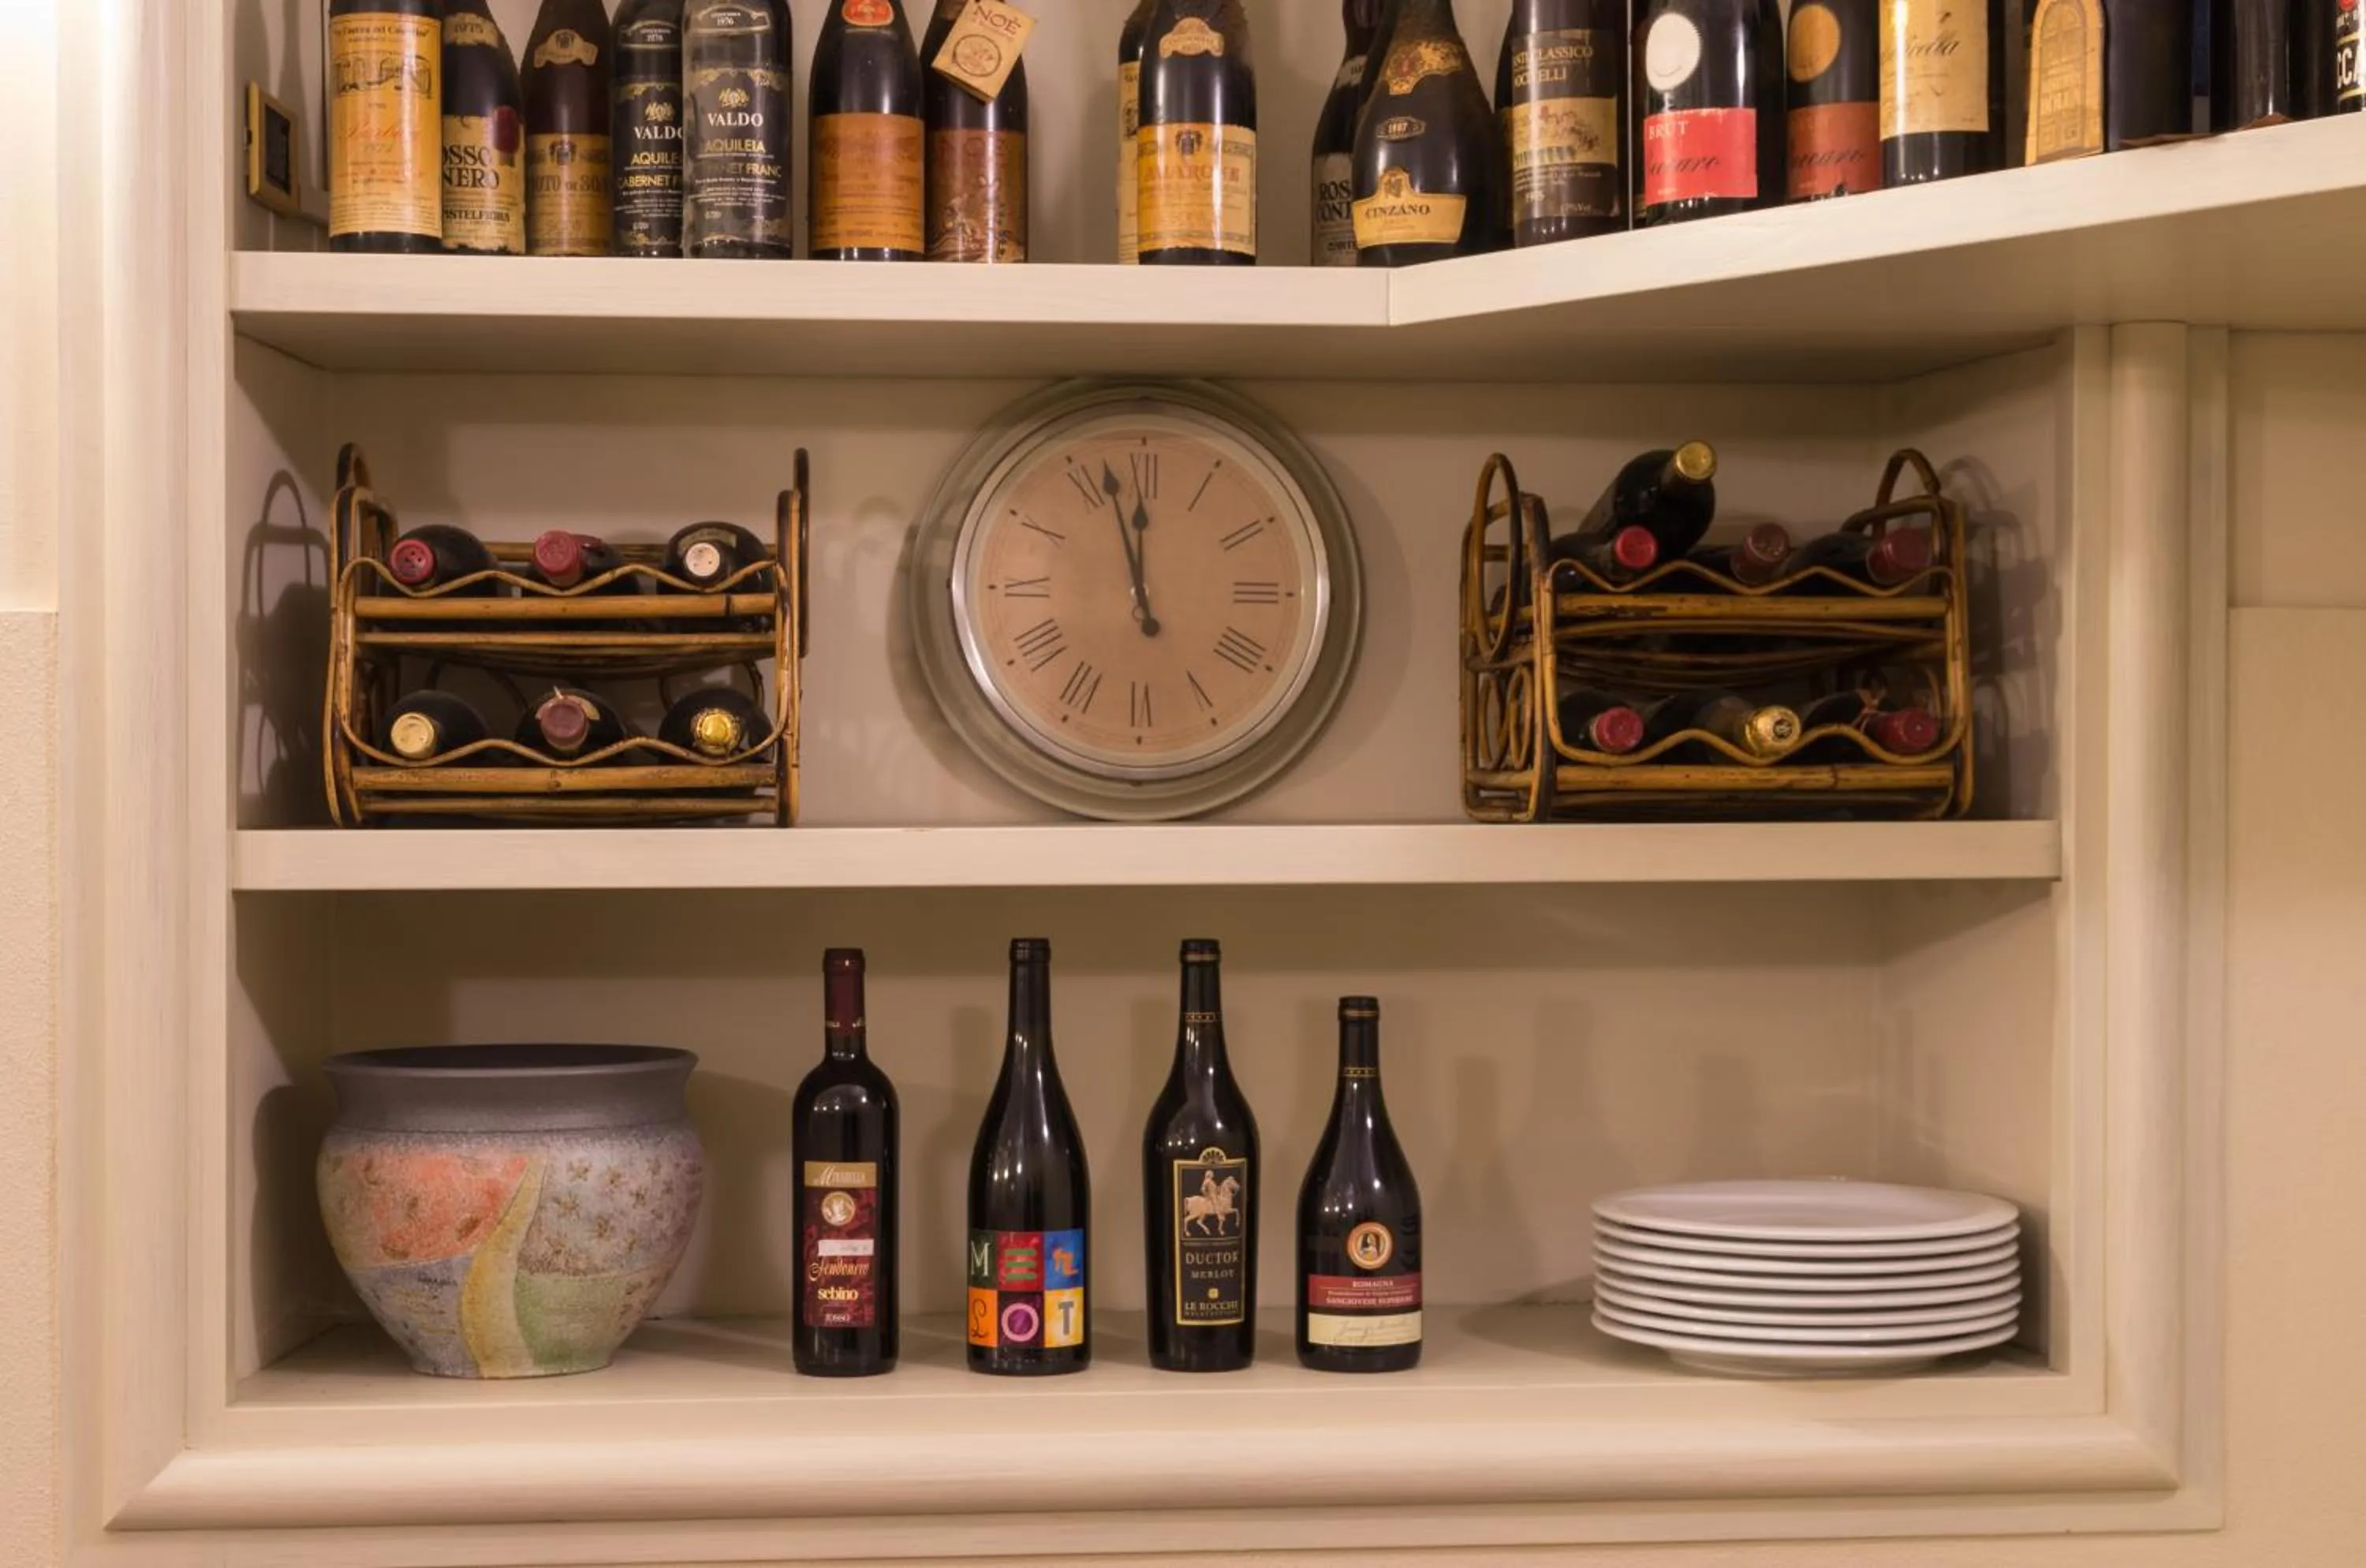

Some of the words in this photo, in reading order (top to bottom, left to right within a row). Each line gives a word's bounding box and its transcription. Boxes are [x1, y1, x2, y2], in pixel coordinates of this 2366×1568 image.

[708, 112, 764, 127] VALDO
[705, 138, 766, 153] AQUILEIA
[745, 161, 782, 177] FRANC
[618, 174, 670, 189] CABERNET
[1185, 1250, 1239, 1265] DUCTOR
[1191, 1269, 1236, 1279] MERLOT
[817, 1286, 859, 1301] sebino
